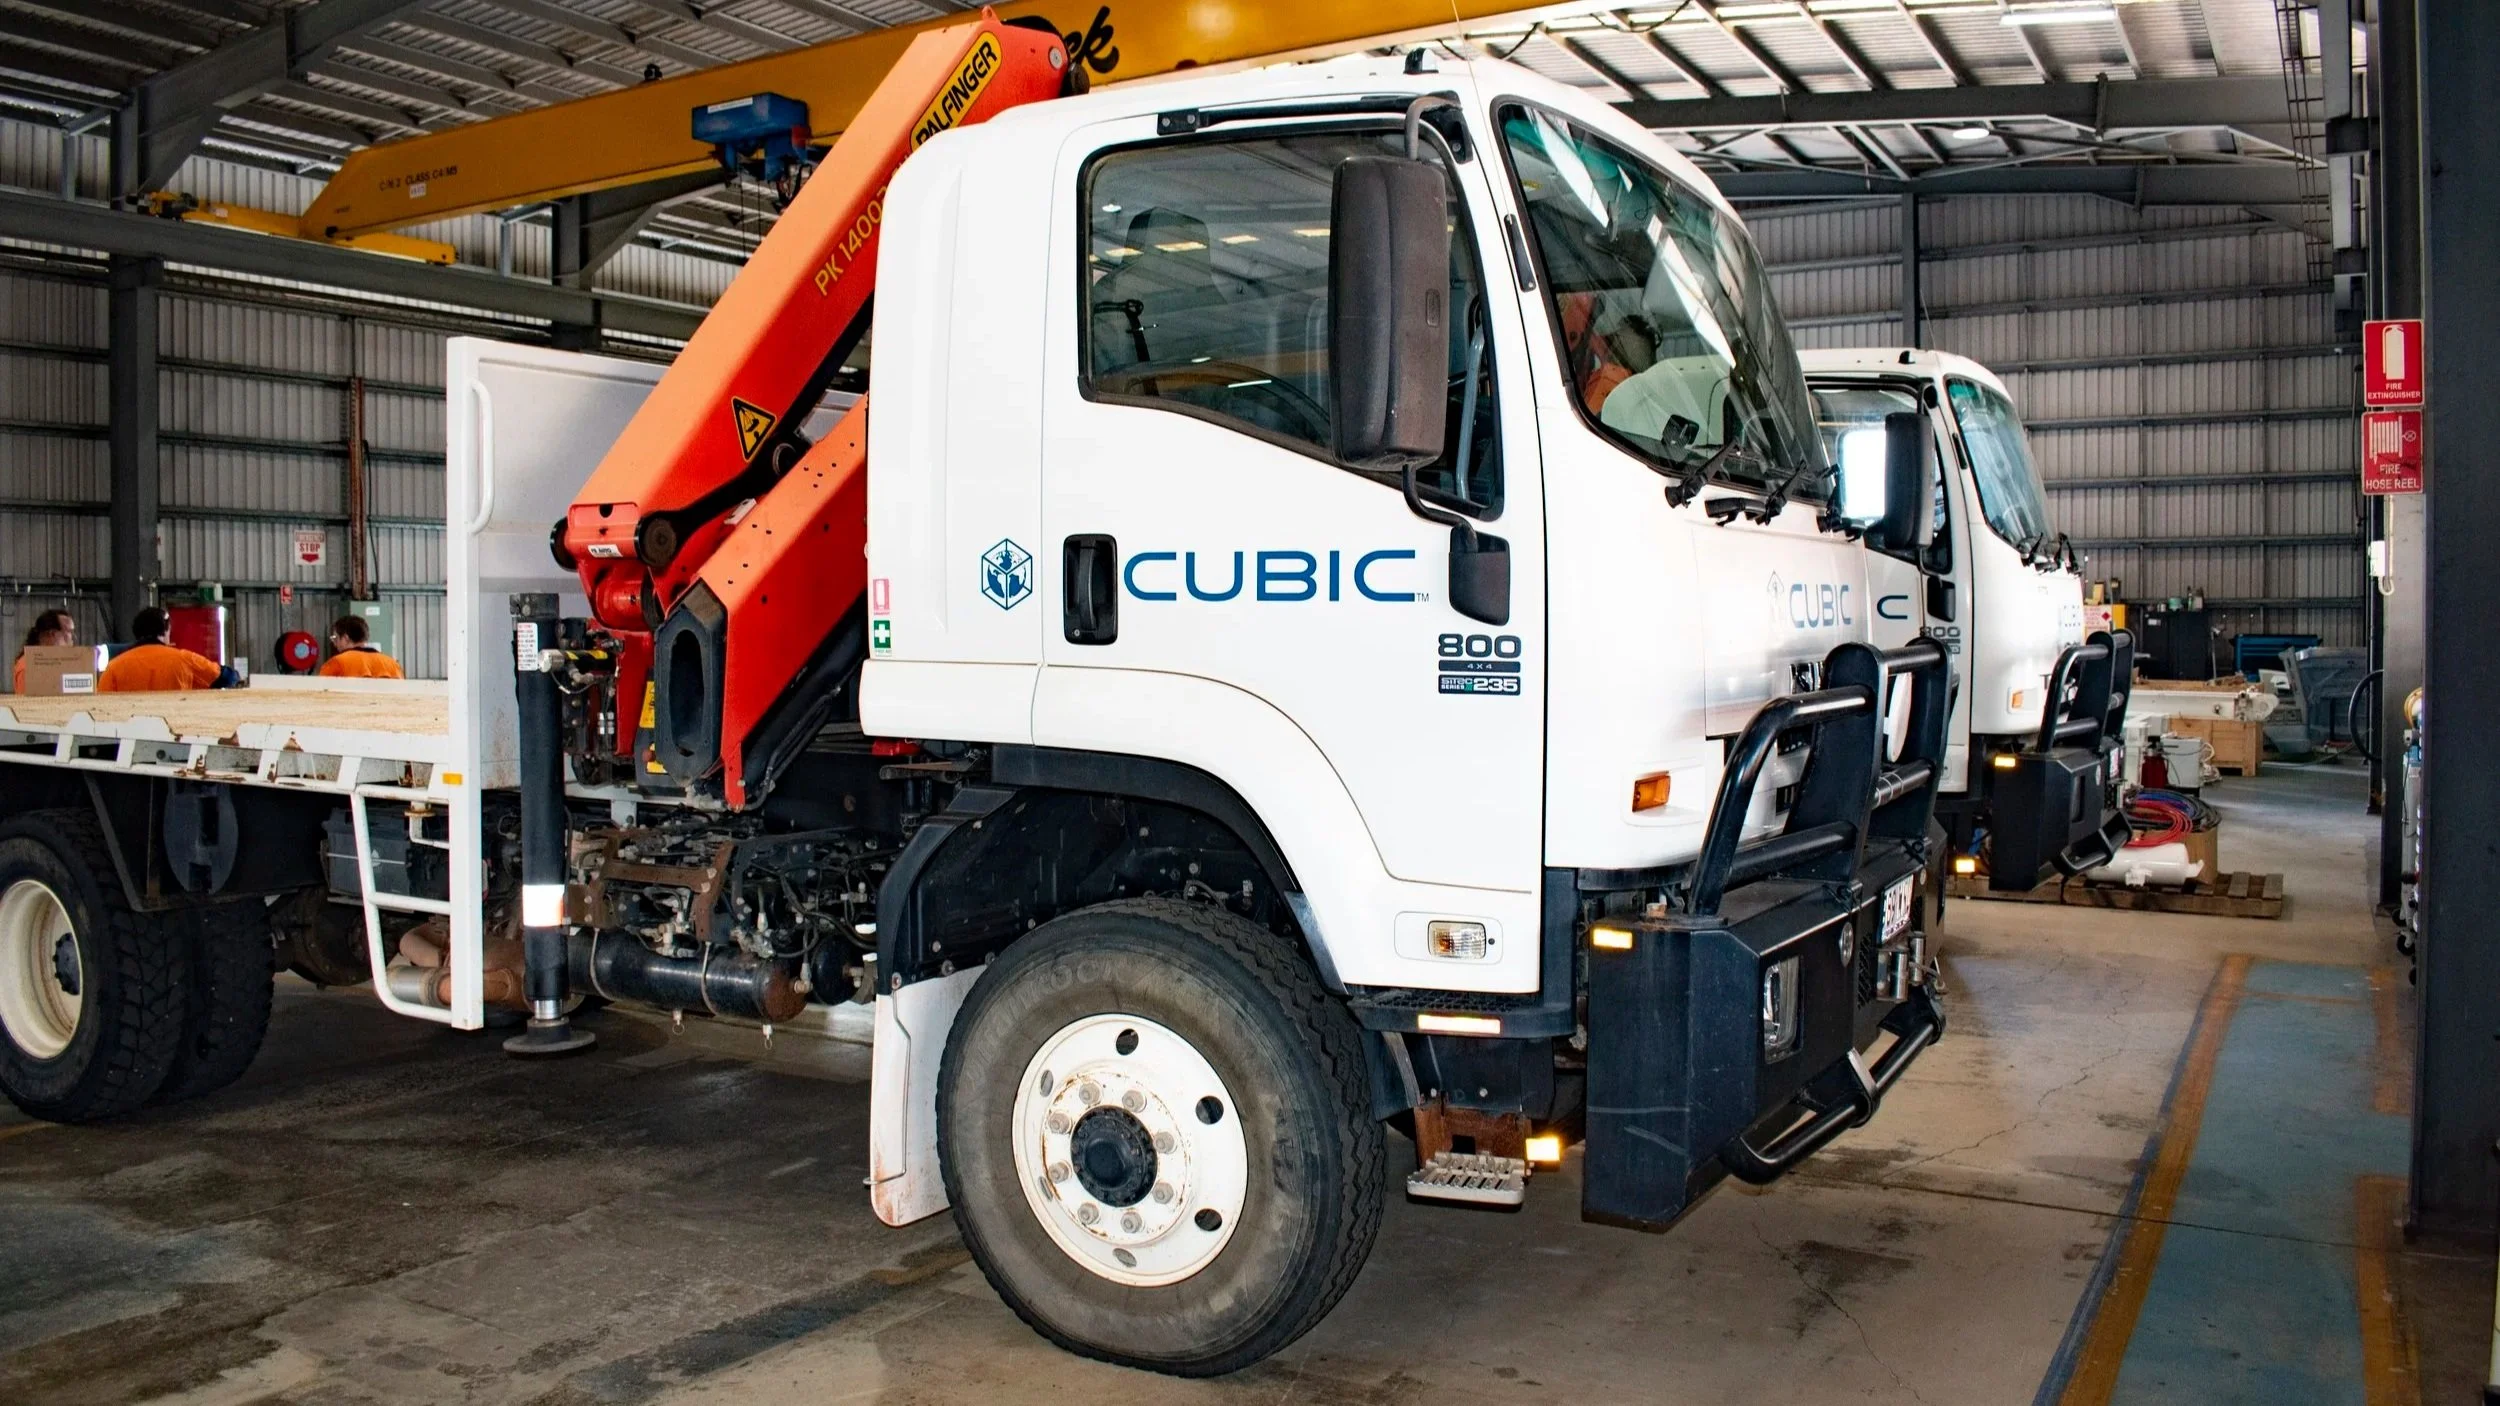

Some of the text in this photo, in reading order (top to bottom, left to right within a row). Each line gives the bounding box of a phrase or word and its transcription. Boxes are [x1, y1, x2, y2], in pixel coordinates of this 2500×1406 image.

[916, 41, 998, 146] PALFINGER
[815, 254, 843, 296] PK
[2385, 382, 2402, 391] FIRE
[2367, 390, 2421, 400] EXTINGUISHER
[2380, 463, 2401, 475] FIRE
[2365, 478, 2420, 490] HOSE REEL
[300, 542, 321, 553] STOP
[1123, 550, 1416, 602] CUBIC
[1789, 583, 1852, 629] CUBIC
[1437, 633, 1522, 659] 800
[1473, 678, 1518, 692] 235
